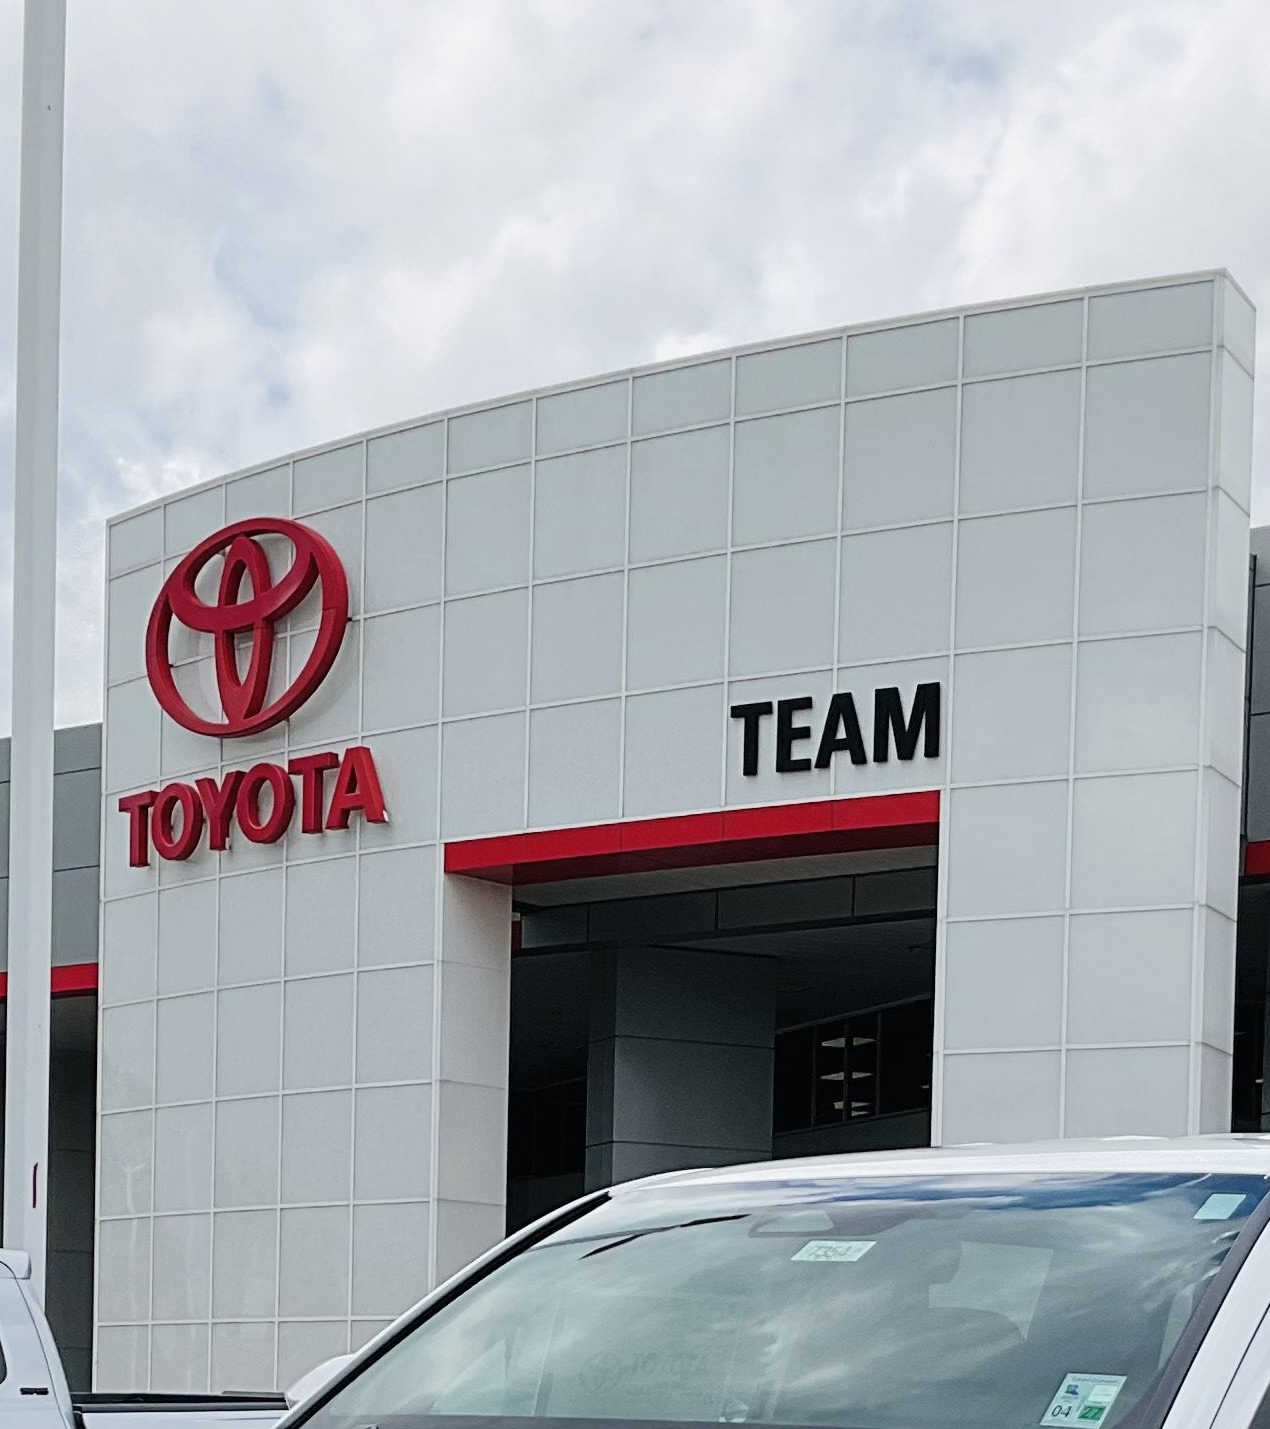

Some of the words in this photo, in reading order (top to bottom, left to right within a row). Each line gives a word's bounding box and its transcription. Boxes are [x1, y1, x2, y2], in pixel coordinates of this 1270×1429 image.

[730, 682, 941, 776] TEAM
[119, 745, 388, 867] TOYOTA
[1051, 1405, 1072, 1417] 04
